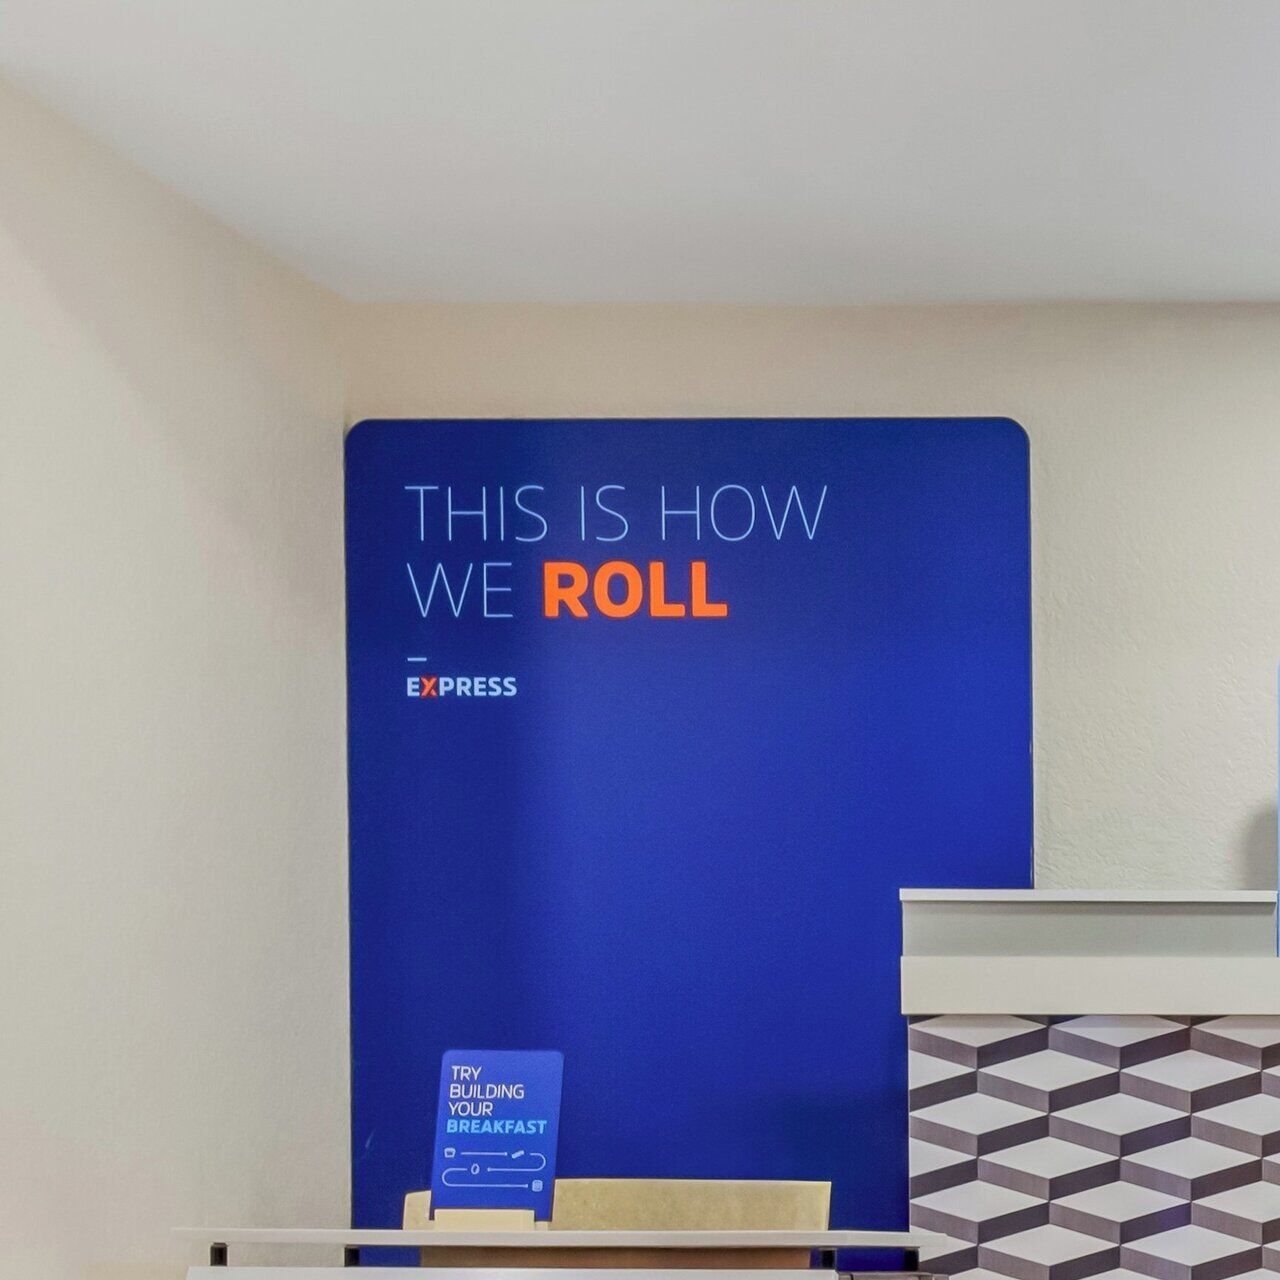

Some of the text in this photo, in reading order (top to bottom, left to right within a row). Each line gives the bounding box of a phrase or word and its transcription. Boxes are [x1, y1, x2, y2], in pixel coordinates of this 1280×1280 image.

[405, 484, 828, 542] THIS IS HOW
[406, 561, 729, 618] WE ROLL
[407, 676, 518, 698] EXPRESS
[451, 1065, 483, 1081] TRY
[450, 1083, 525, 1099] BUILDING
[448, 1101, 494, 1116] YOUR
[446, 1119, 548, 1135] BREAKFAST
